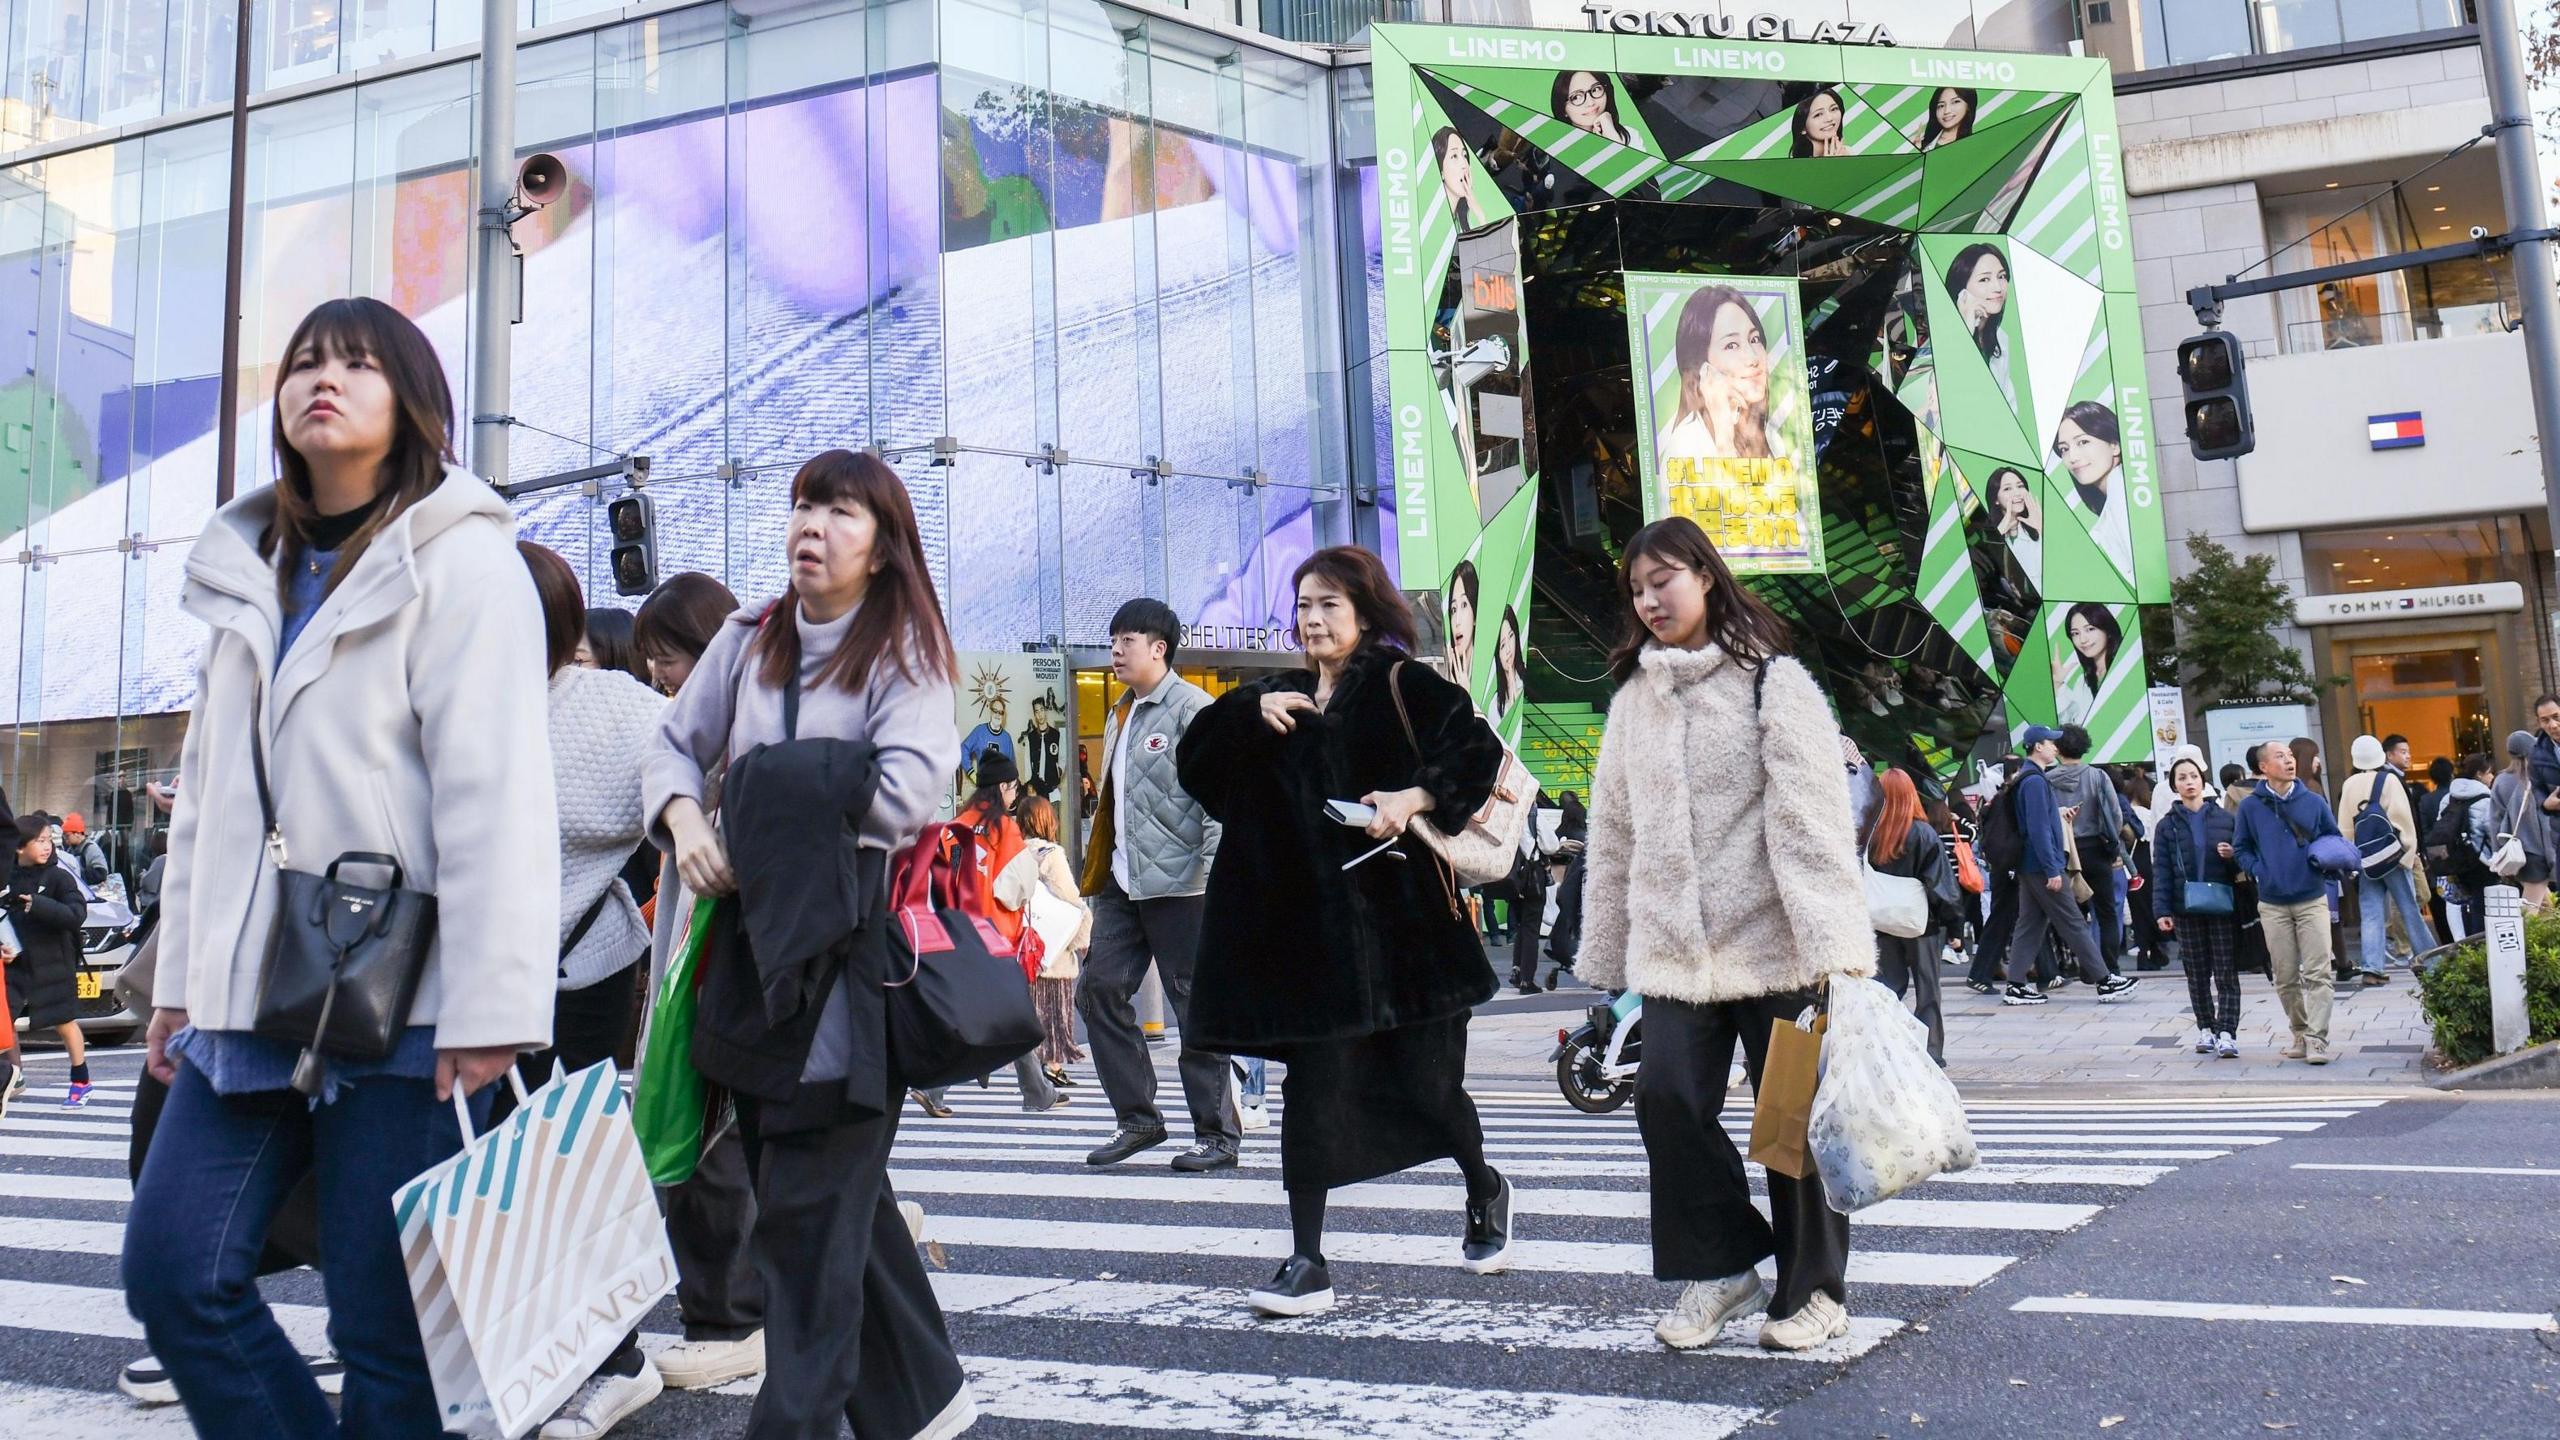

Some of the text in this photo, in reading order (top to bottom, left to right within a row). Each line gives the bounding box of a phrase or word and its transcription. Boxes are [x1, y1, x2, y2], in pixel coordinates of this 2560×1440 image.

[1581, 3, 1898, 46] TOKYU PLAZA
[1448, 36, 1566, 63] LINEMO
[1673, 47, 1785, 72] LINEMO
[1909, 58, 2016, 82] LINEMO
[2093, 133, 2123, 251] LINEMO
[1386, 147, 1414, 275] LINEMO
[1473, 272, 1515, 311] bills
[2121, 387, 2153, 508] LINEMO
[1399, 404, 1428, 537] LINEMO
[1667, 457, 1793, 483] #LINEMO
[2329, 593, 2485, 614] TOMMY HILFIGER
[1179, 624, 1268, 650] SHEL'TTER
[1032, 658, 1061, 667] PERSON'S
[2219, 697, 2253, 706] TOKYU
[2495, 921, 2520, 952] NERO
[500, 1255, 669, 1425] DAIMARU
